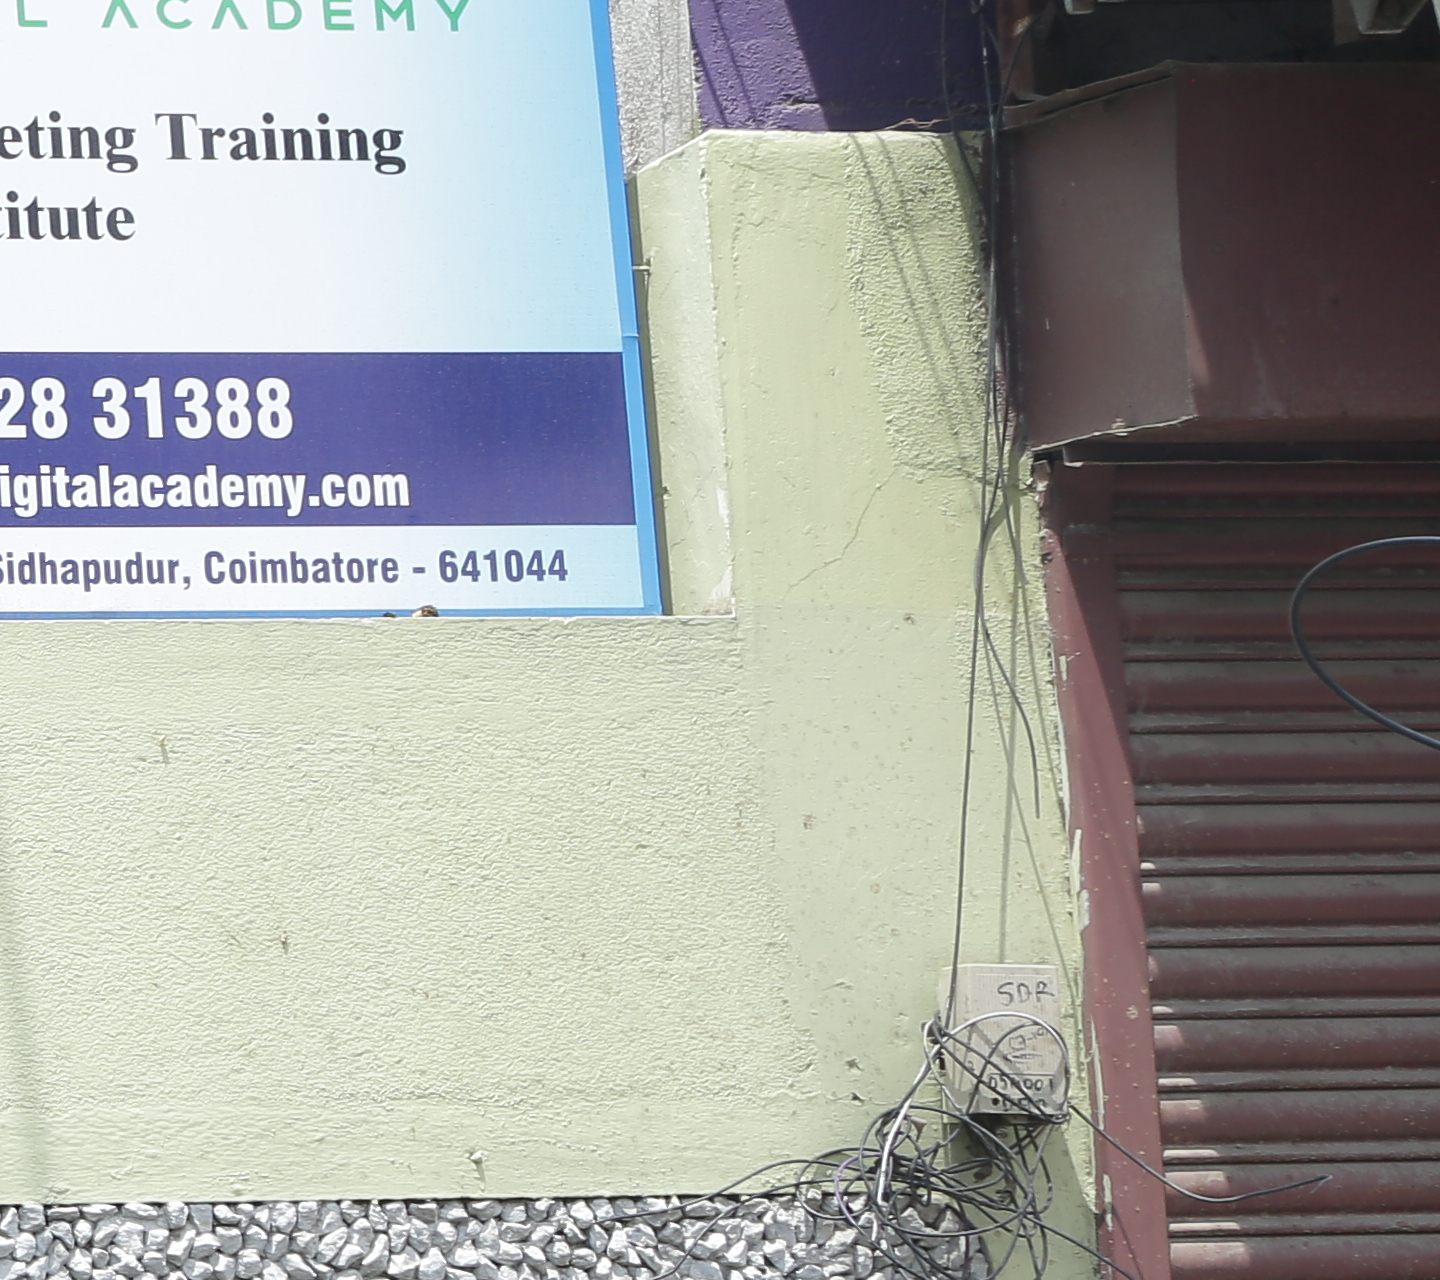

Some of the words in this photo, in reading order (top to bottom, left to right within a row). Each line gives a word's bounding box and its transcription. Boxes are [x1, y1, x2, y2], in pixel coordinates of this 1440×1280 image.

[155, 112, 407, 175] Training
[92, 377, 294, 440] 31388
[204, 551, 399, 585] Coimbatore
[439, 549, 568, 583] 641044
